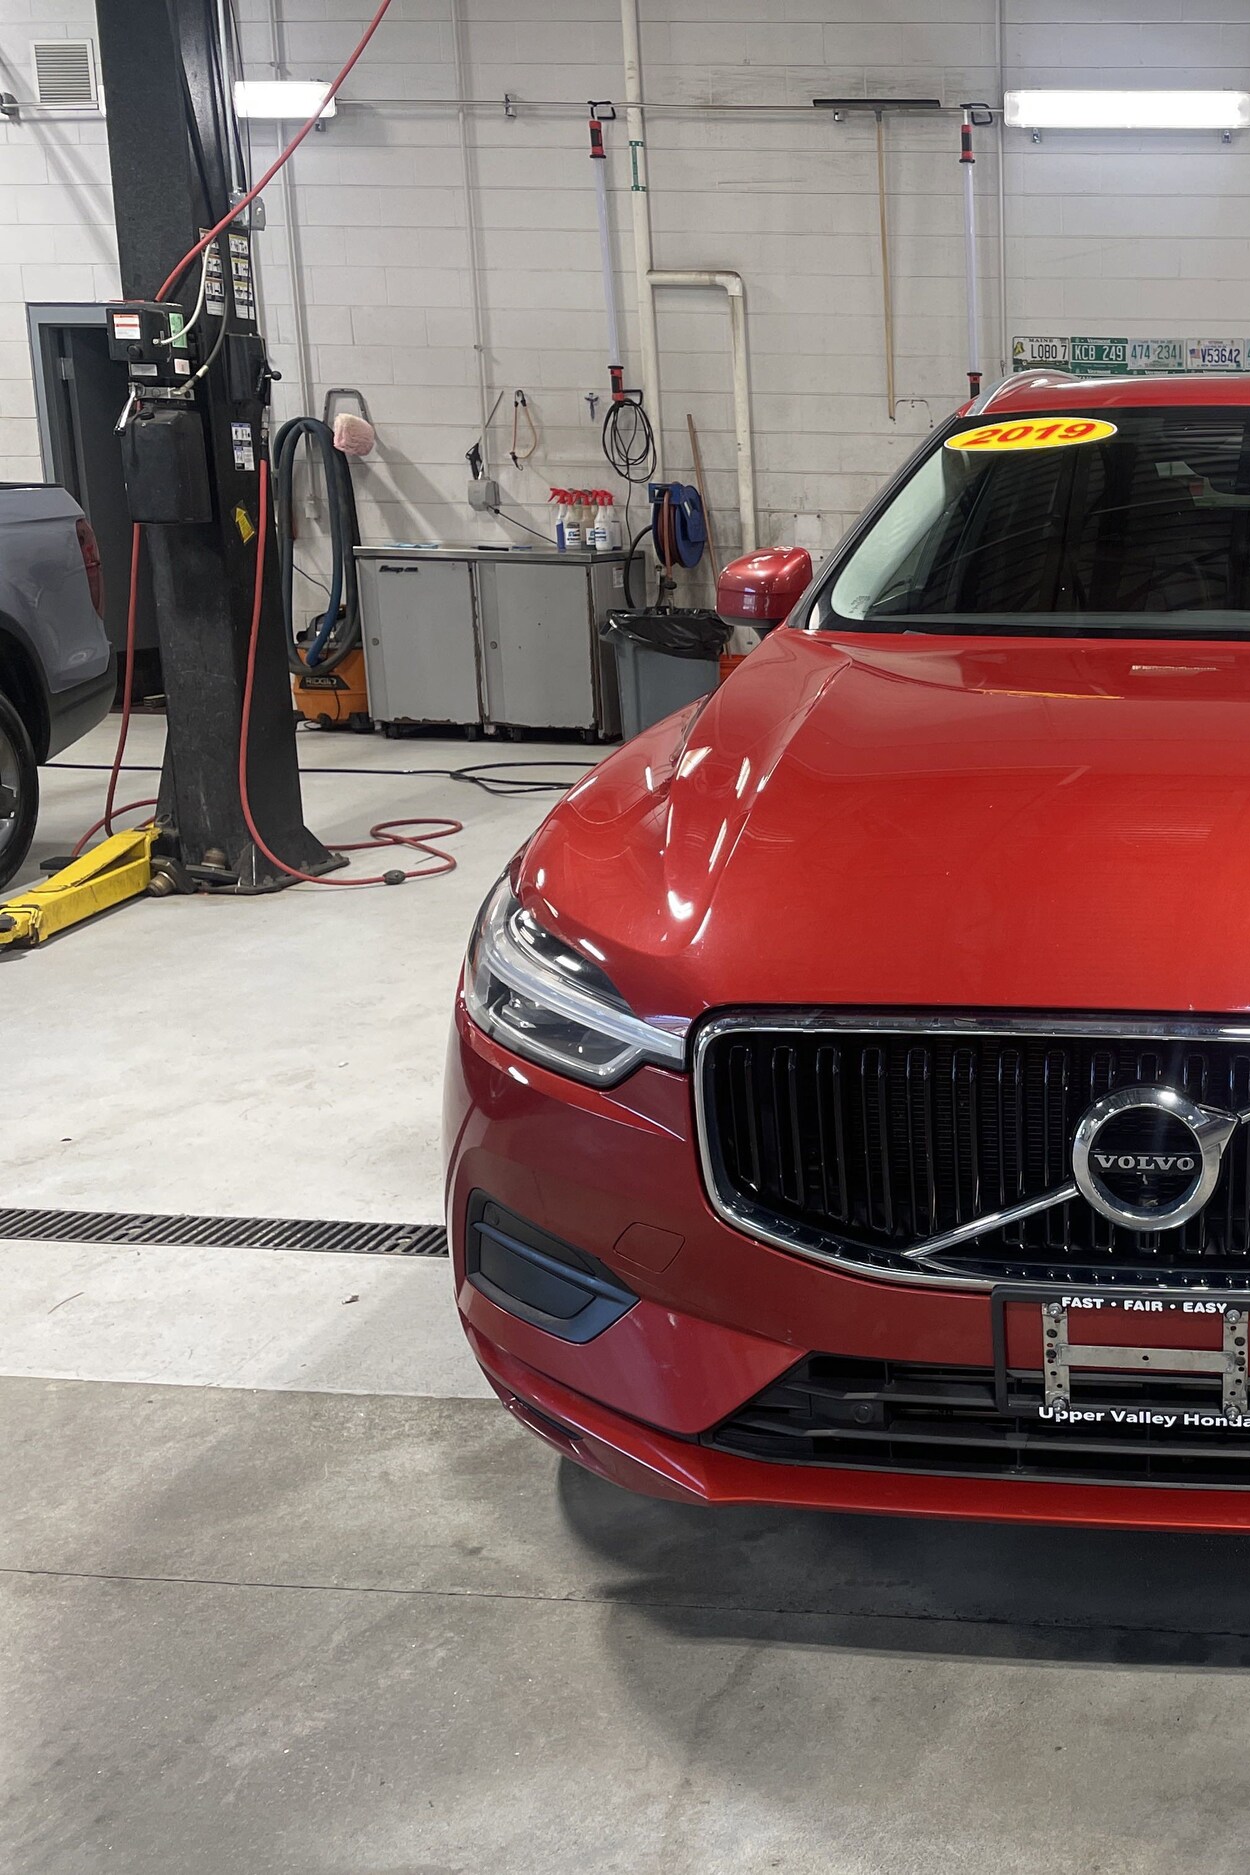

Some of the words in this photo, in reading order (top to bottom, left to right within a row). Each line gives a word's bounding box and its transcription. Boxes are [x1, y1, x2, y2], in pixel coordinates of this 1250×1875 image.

[1060, 345, 1067, 360] 7
[1074, 345, 1096, 361] KCB
[1102, 345, 1123, 361] 249
[1130, 344, 1151, 360] 474
[1157, 344, 1183, 360] 2341
[1200, 348, 1241, 363] V53642
[959, 422, 1097, 447] 2019
[1094, 1154, 1195, 1171] VOLVO
[1061, 1296, 1104, 1309] FAST
[1124, 1300, 1163, 1312] FAIR
[1183, 1302, 1227, 1314] EASY
[1038, 1406, 1105, 1423] Upper
[1110, 1410, 1177, 1428] Valley
